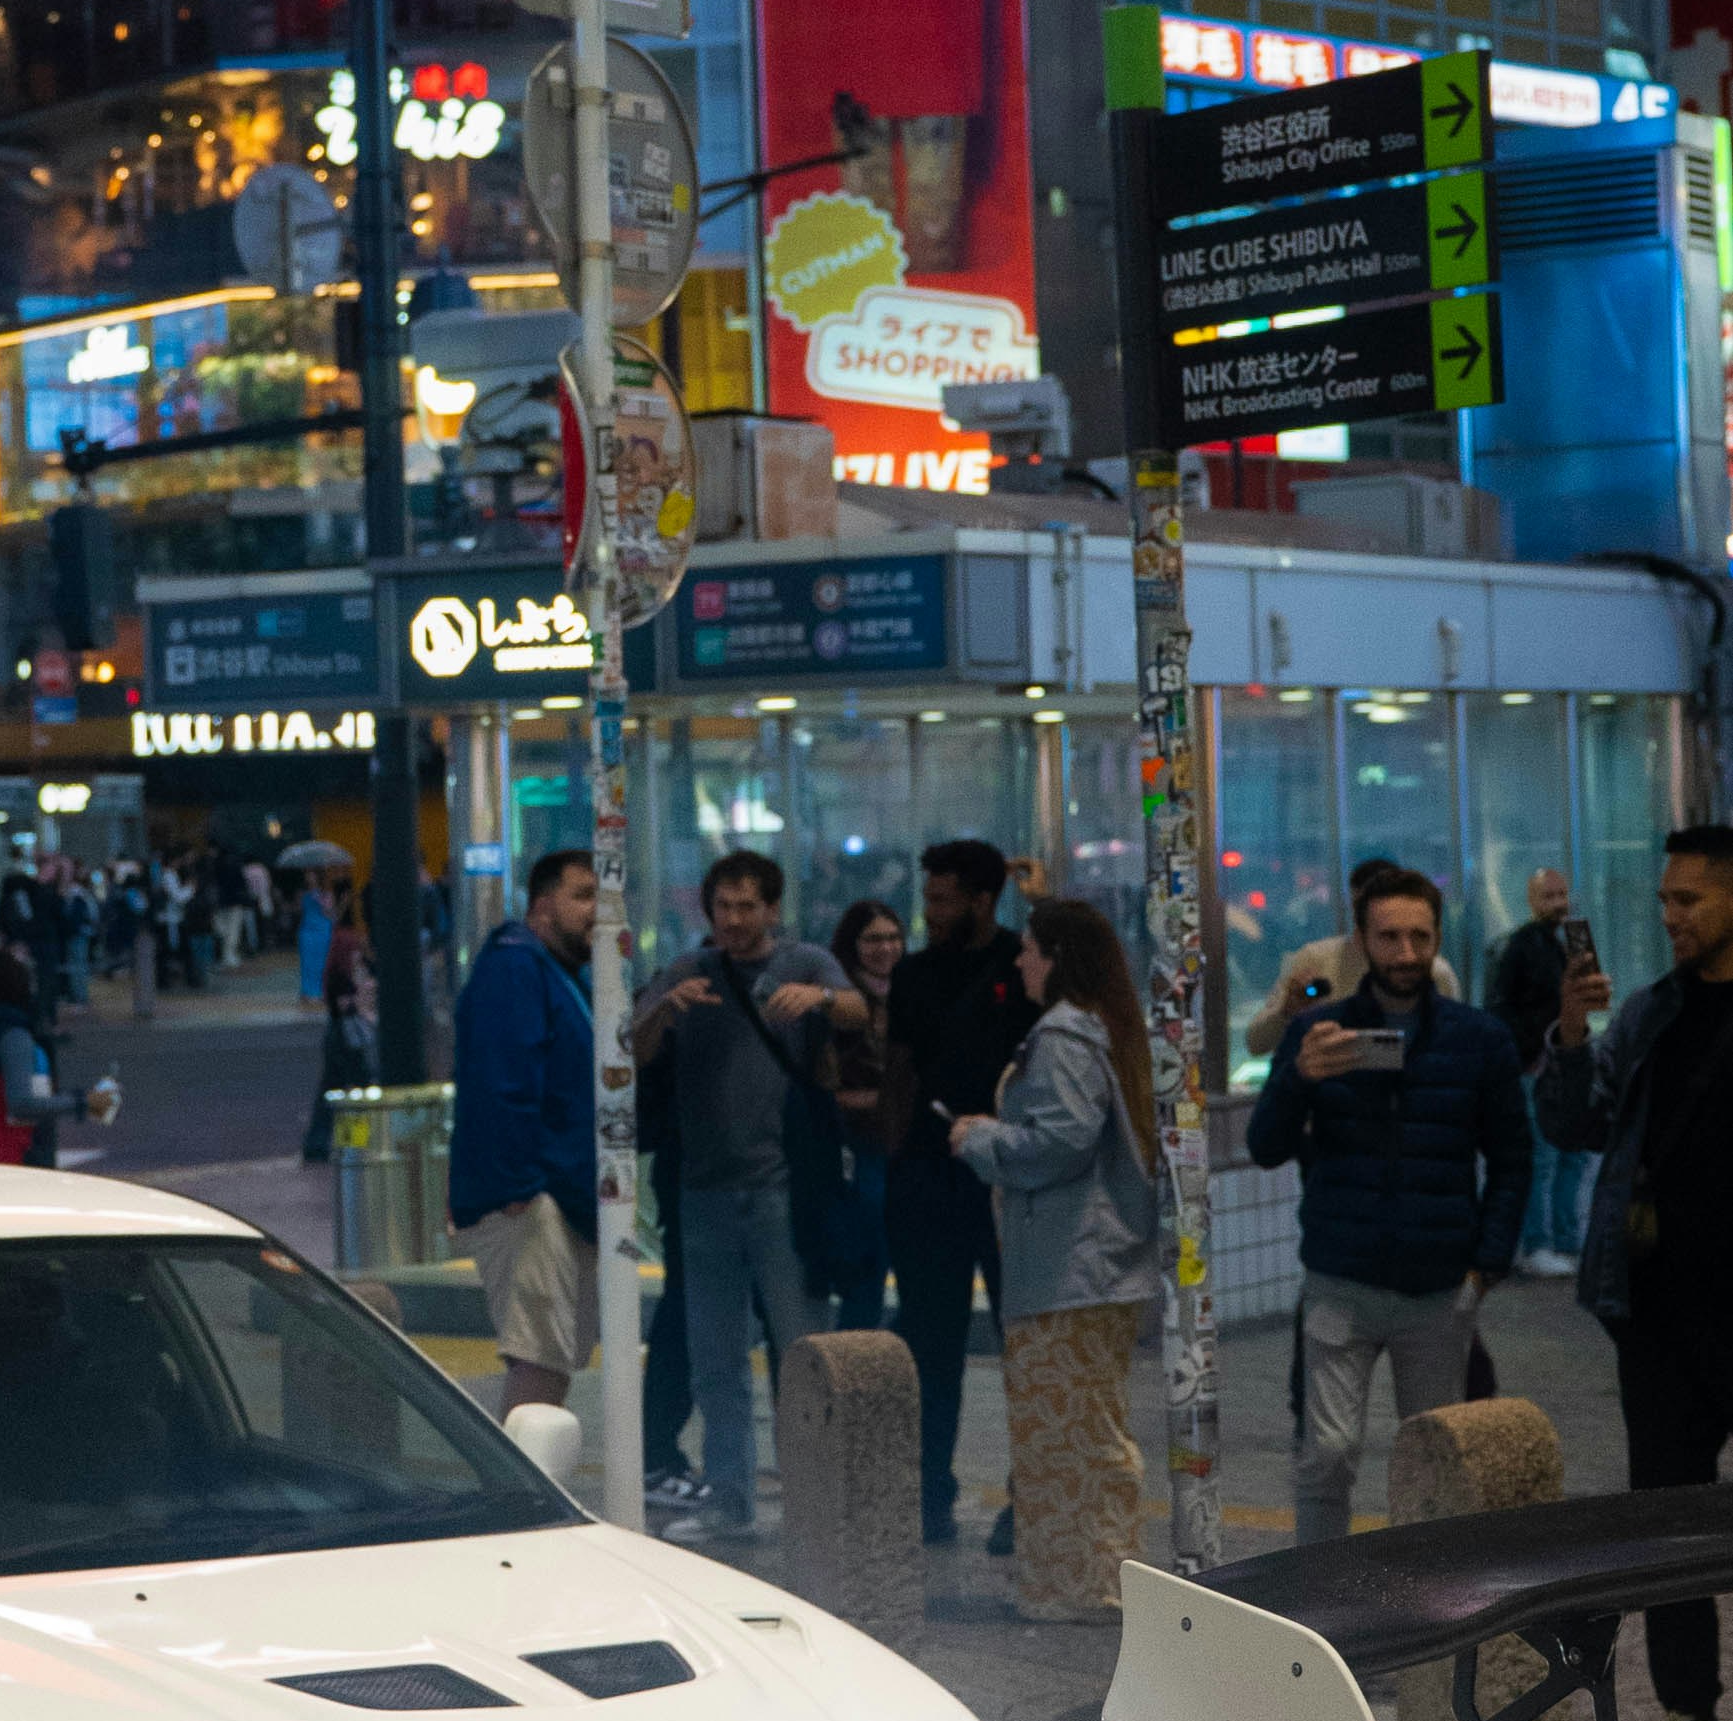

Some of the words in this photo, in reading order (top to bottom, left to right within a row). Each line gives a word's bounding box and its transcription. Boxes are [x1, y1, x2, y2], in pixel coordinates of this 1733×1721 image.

[1220, 105, 1331, 157] 渋谷区役所
[1221, 152, 1284, 184] Shibuya
[1286, 142, 1319, 172] City
[1320, 137, 1371, 162] Office
[1160, 252, 1205, 281] LINE
[1210, 237, 1267, 269] CUBE
[1270, 219, 1369, 260] SHIBUYA
[1248, 266, 1305, 296] Shibuya
[1306, 260, 1350, 286] Public
[1352, 253, 1382, 278] Hall
[1182, 360, 1235, 395] NHK
[1236, 344, 1359, 387] 放送センター
[1184, 399, 1219, 422] NHK
[1222, 384, 1323, 417] Broadcasting
[1324, 376, 1380, 400] Center
